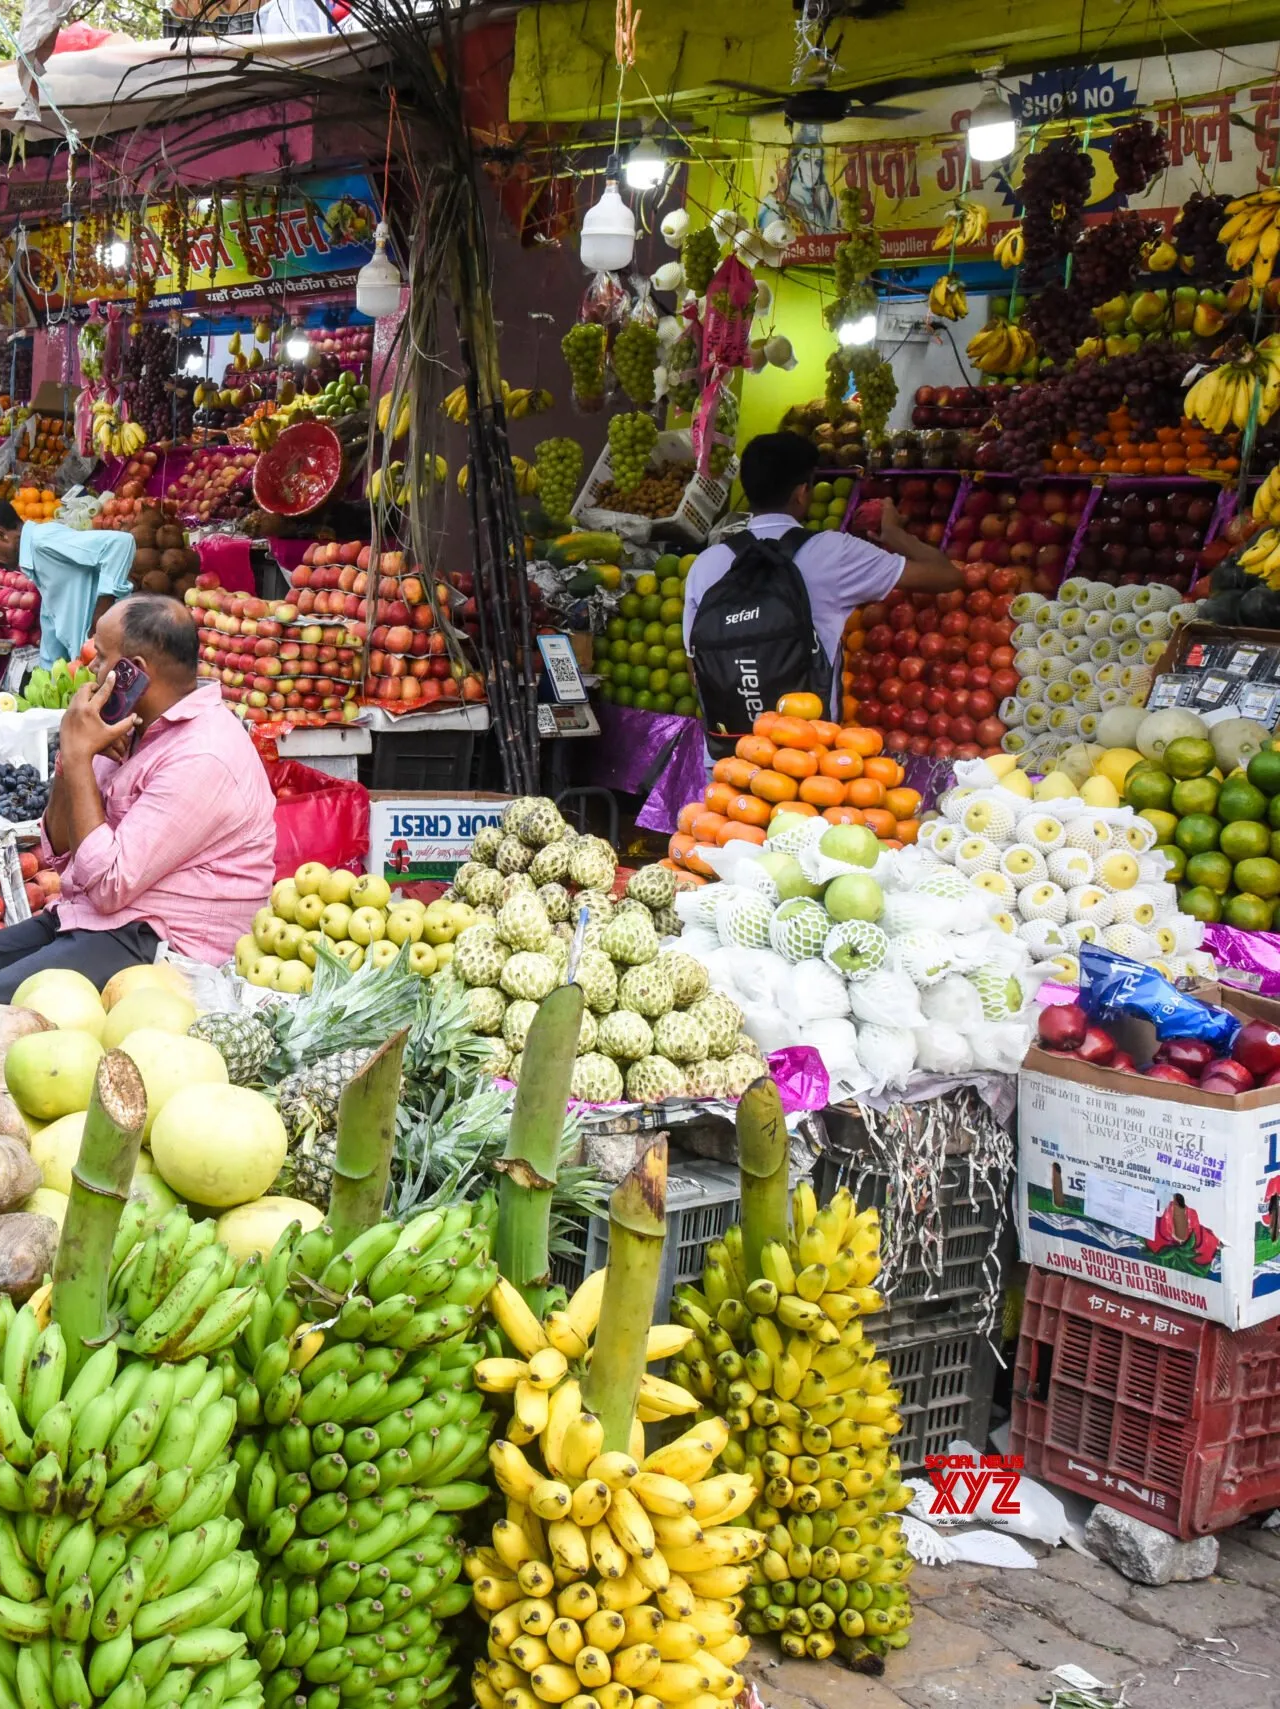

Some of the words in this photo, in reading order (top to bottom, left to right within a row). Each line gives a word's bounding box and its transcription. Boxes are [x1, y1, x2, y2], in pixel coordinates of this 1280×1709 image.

[1084, 86, 1115, 109] NO
[840, 142, 920, 225] गुप्ता
[808, 242, 831, 257] Sale
[390, 815, 452, 837] CREST
[1082, 1110, 1142, 1134] DELICIOUS
[1087, 1123, 1120, 1140] FANCY
[1149, 1124, 1173, 1140] RED
[1141, 1136, 1173, 1153] WASH
[1175, 1131, 1206, 1152] 125
[1172, 1158, 1182, 1169] OF
[1183, 1162, 1200, 1175] DEPT
[1119, 1168, 1137, 1179] FRUIT
[1139, 1173, 1160, 1184] EVANS
[1201, 1168, 1222, 1181] WASH
[1172, 1181, 1201, 1192] PACKED
[1046, 1252, 1083, 1273] FANCY
[1080, 1247, 1141, 1276] DELICIOUS
[1086, 1262, 1122, 1285] EXTRA
[1145, 1267, 1167, 1283] RED
[1126, 1278, 1208, 1310] WASHINGTON
